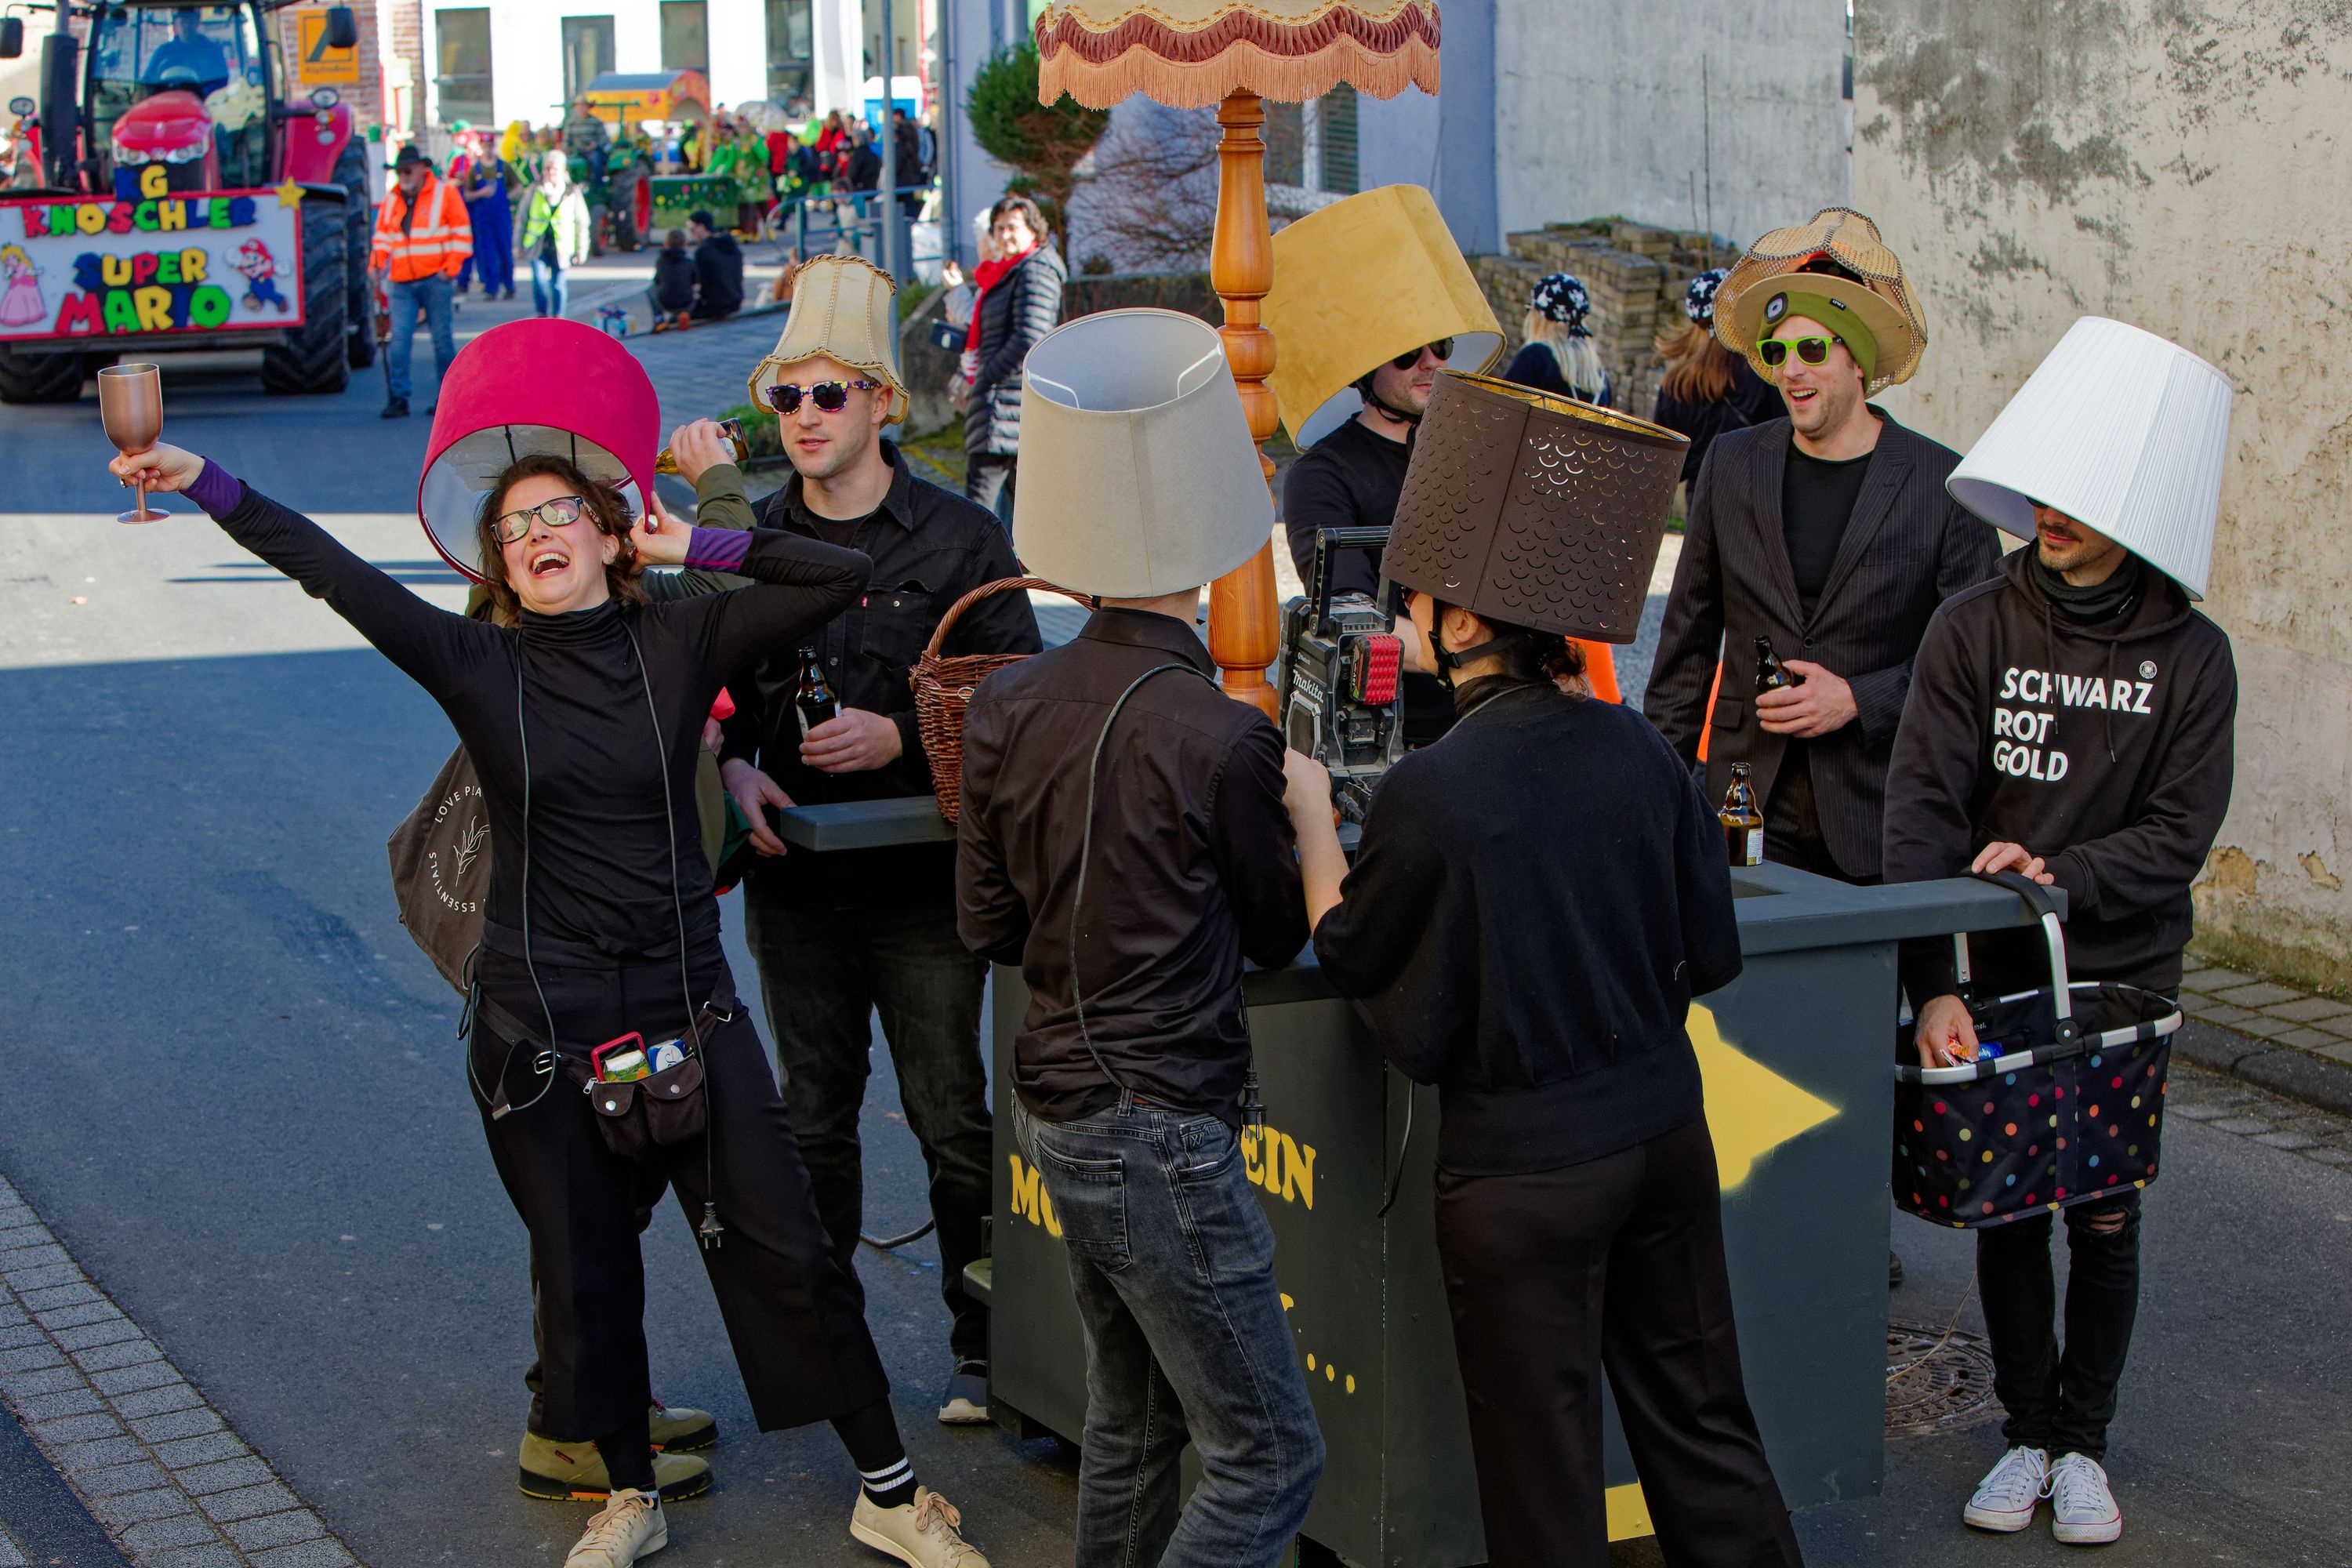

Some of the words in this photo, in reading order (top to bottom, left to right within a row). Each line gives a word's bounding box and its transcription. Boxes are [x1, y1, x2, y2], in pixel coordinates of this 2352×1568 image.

[114, 165, 168, 201] KG
[21, 198, 256, 238] KNOSCHLER
[73, 247, 208, 291] SUPER
[54, 285, 231, 336] MARIO
[1999, 667, 2154, 714] SCHWARZ
[1994, 707, 2054, 744] ROT
[1993, 740, 2069, 782] GOLD
[434, 791, 461, 823] LOVE
[429, 852, 476, 913] ESSENTIALS
